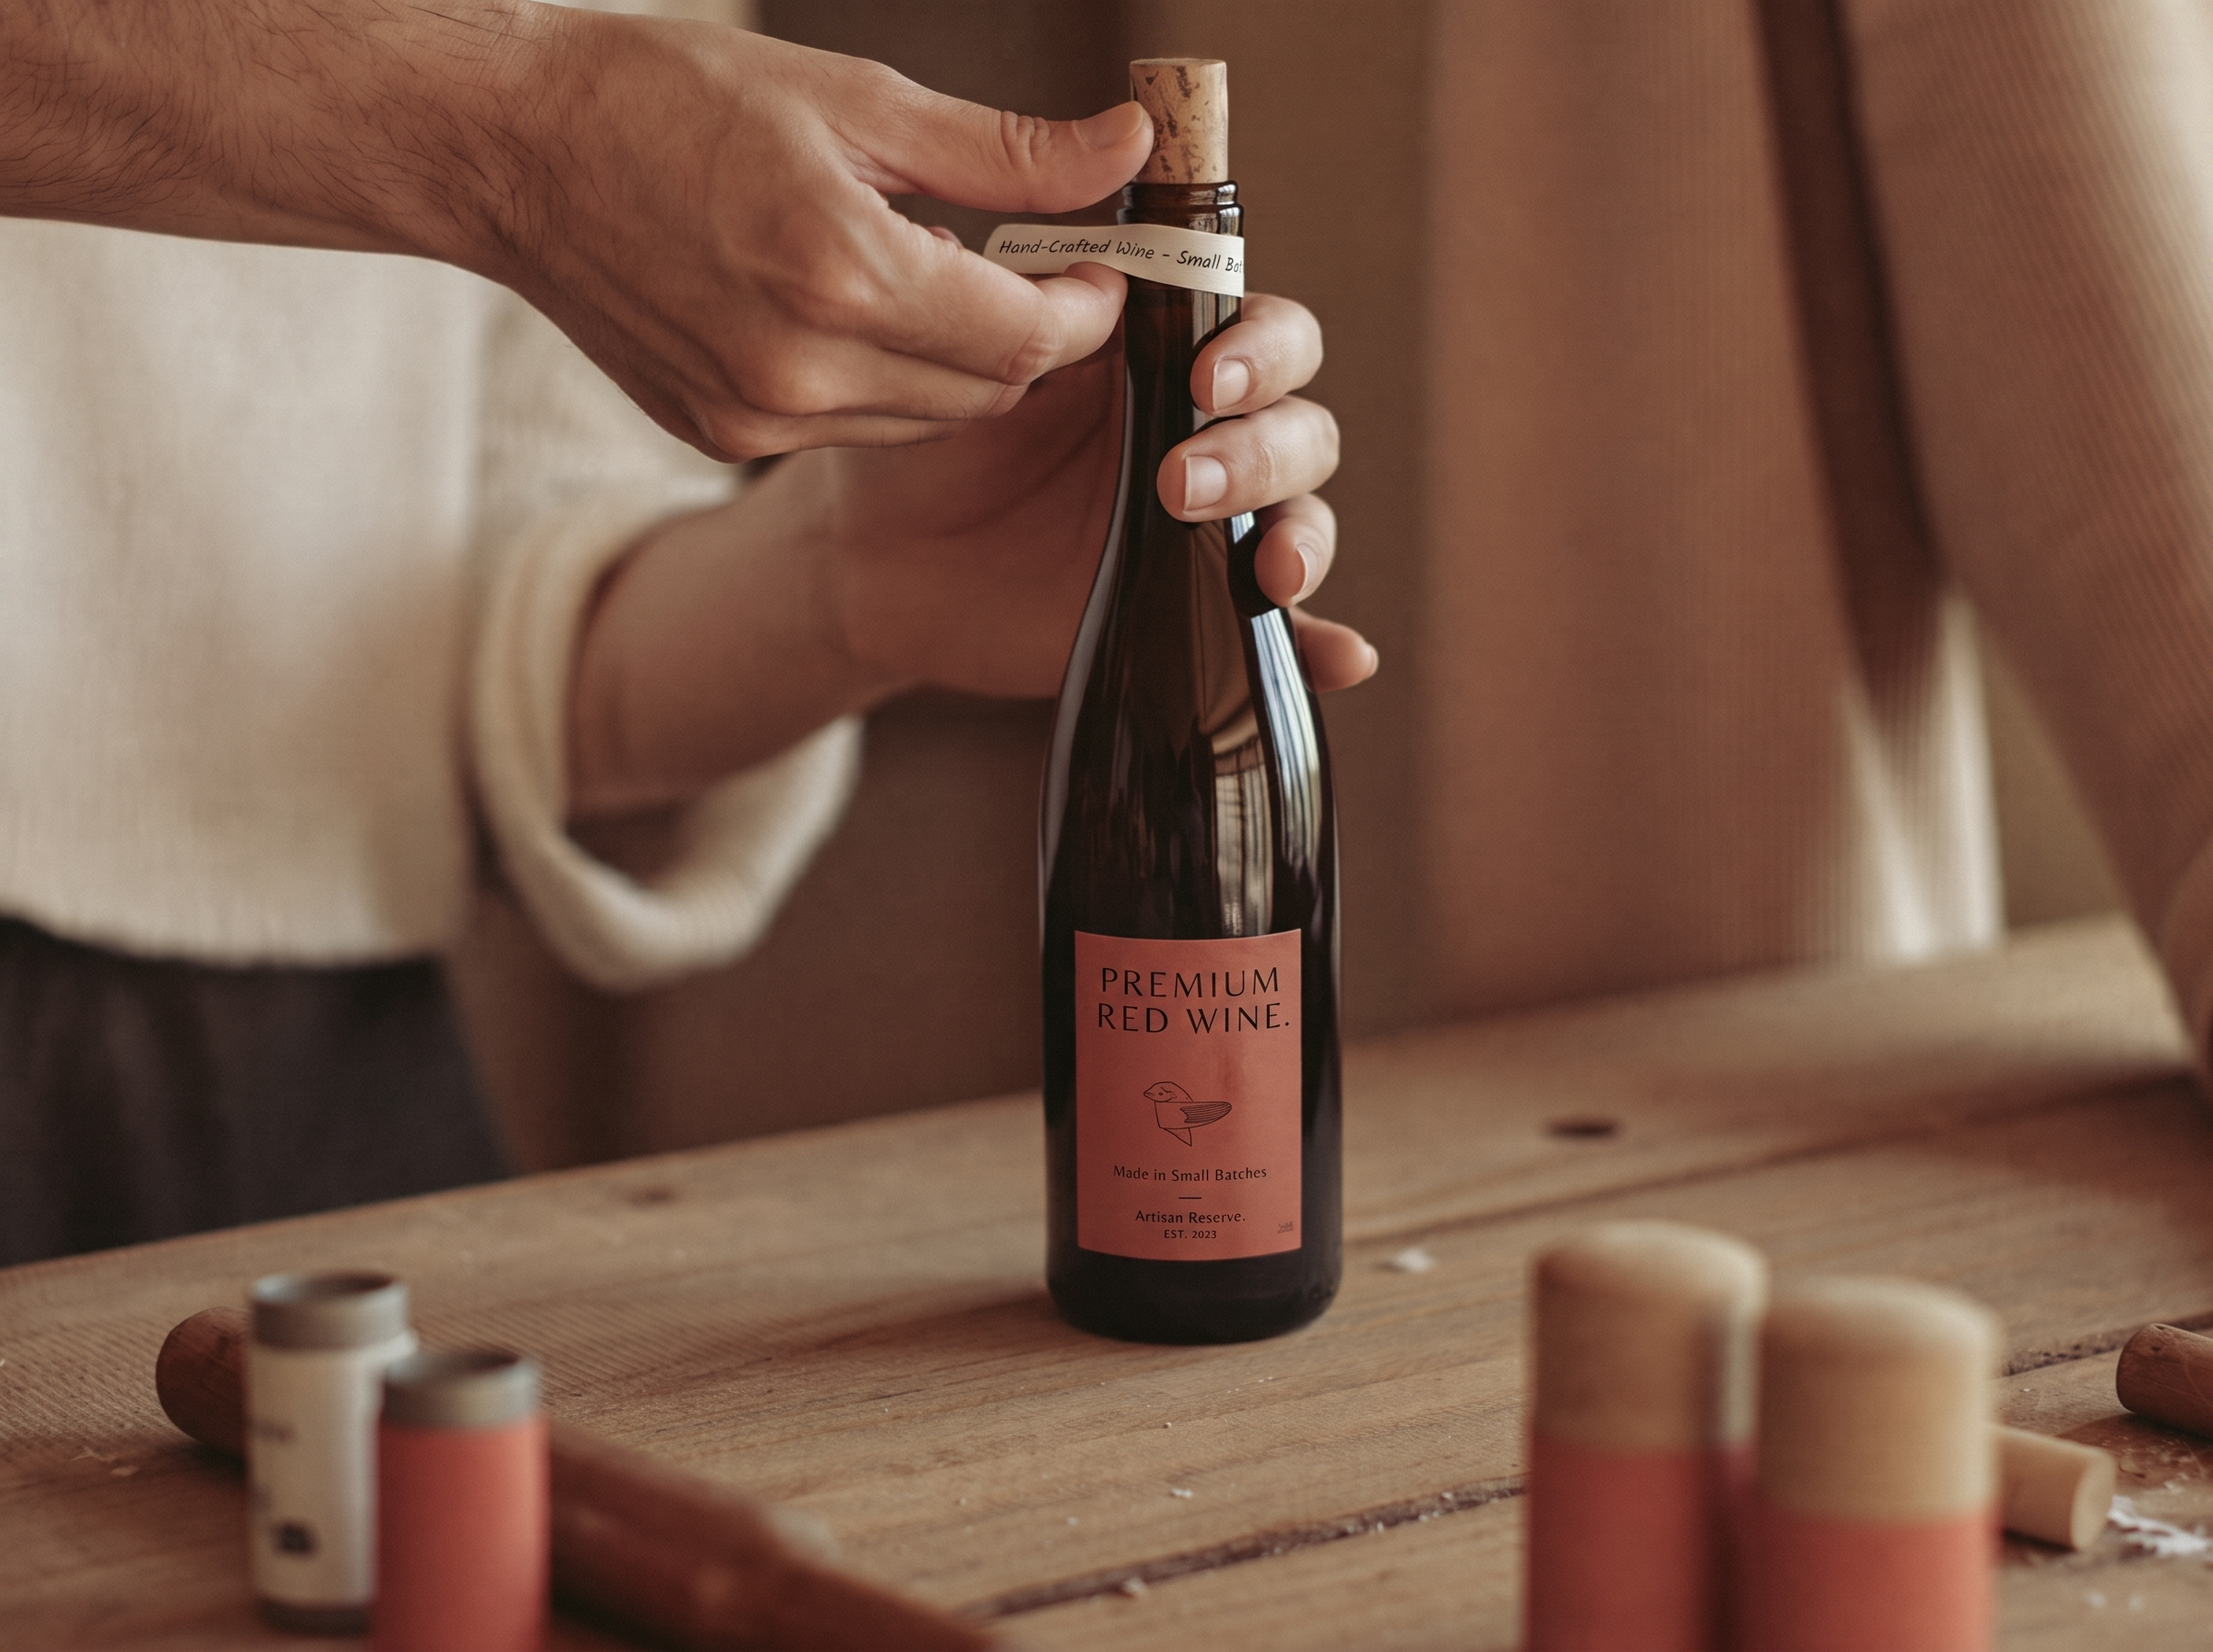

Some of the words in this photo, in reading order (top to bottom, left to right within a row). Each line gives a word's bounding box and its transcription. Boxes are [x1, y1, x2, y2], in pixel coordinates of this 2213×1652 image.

[999, 239, 1112, 254] Hand-Crafted
[1117, 242, 1154, 259] Wine
[1177, 250, 1221, 270] Small
[1101, 966, 1279, 998] PREMIUM
[1097, 1002, 1168, 1033] RED
[1186, 1002, 1290, 1033] WINE.
[1113, 1165, 1149, 1180] Made
[1154, 1169, 1166, 1181] in
[1172, 1169, 1210, 1182] Small
[1215, 1167, 1267, 1181] Batches
[1135, 1210, 1183, 1223] Artisan
[1189, 1211, 1246, 1223] Reserve.
[1164, 1230, 1188, 1239] EST.
[1191, 1230, 1217, 1239] 2023
